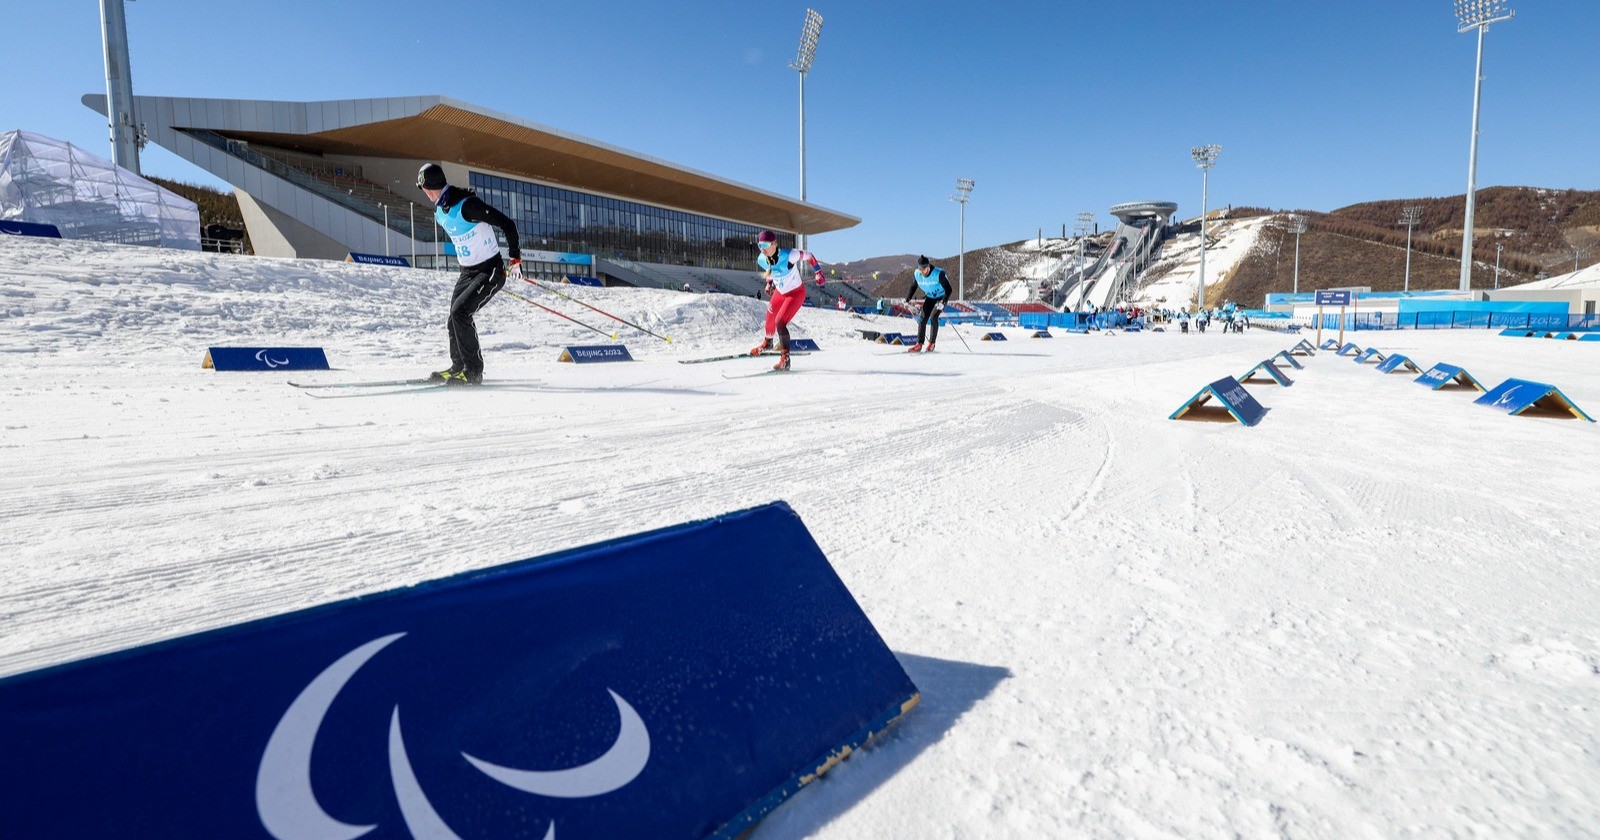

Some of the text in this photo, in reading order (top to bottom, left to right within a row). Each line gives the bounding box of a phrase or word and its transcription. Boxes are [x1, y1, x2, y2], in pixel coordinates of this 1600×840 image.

[357, 255, 384, 264] BEIJING
[1485, 315, 1527, 325] EIJING
[576, 348, 624, 358] BEIJING 2022
